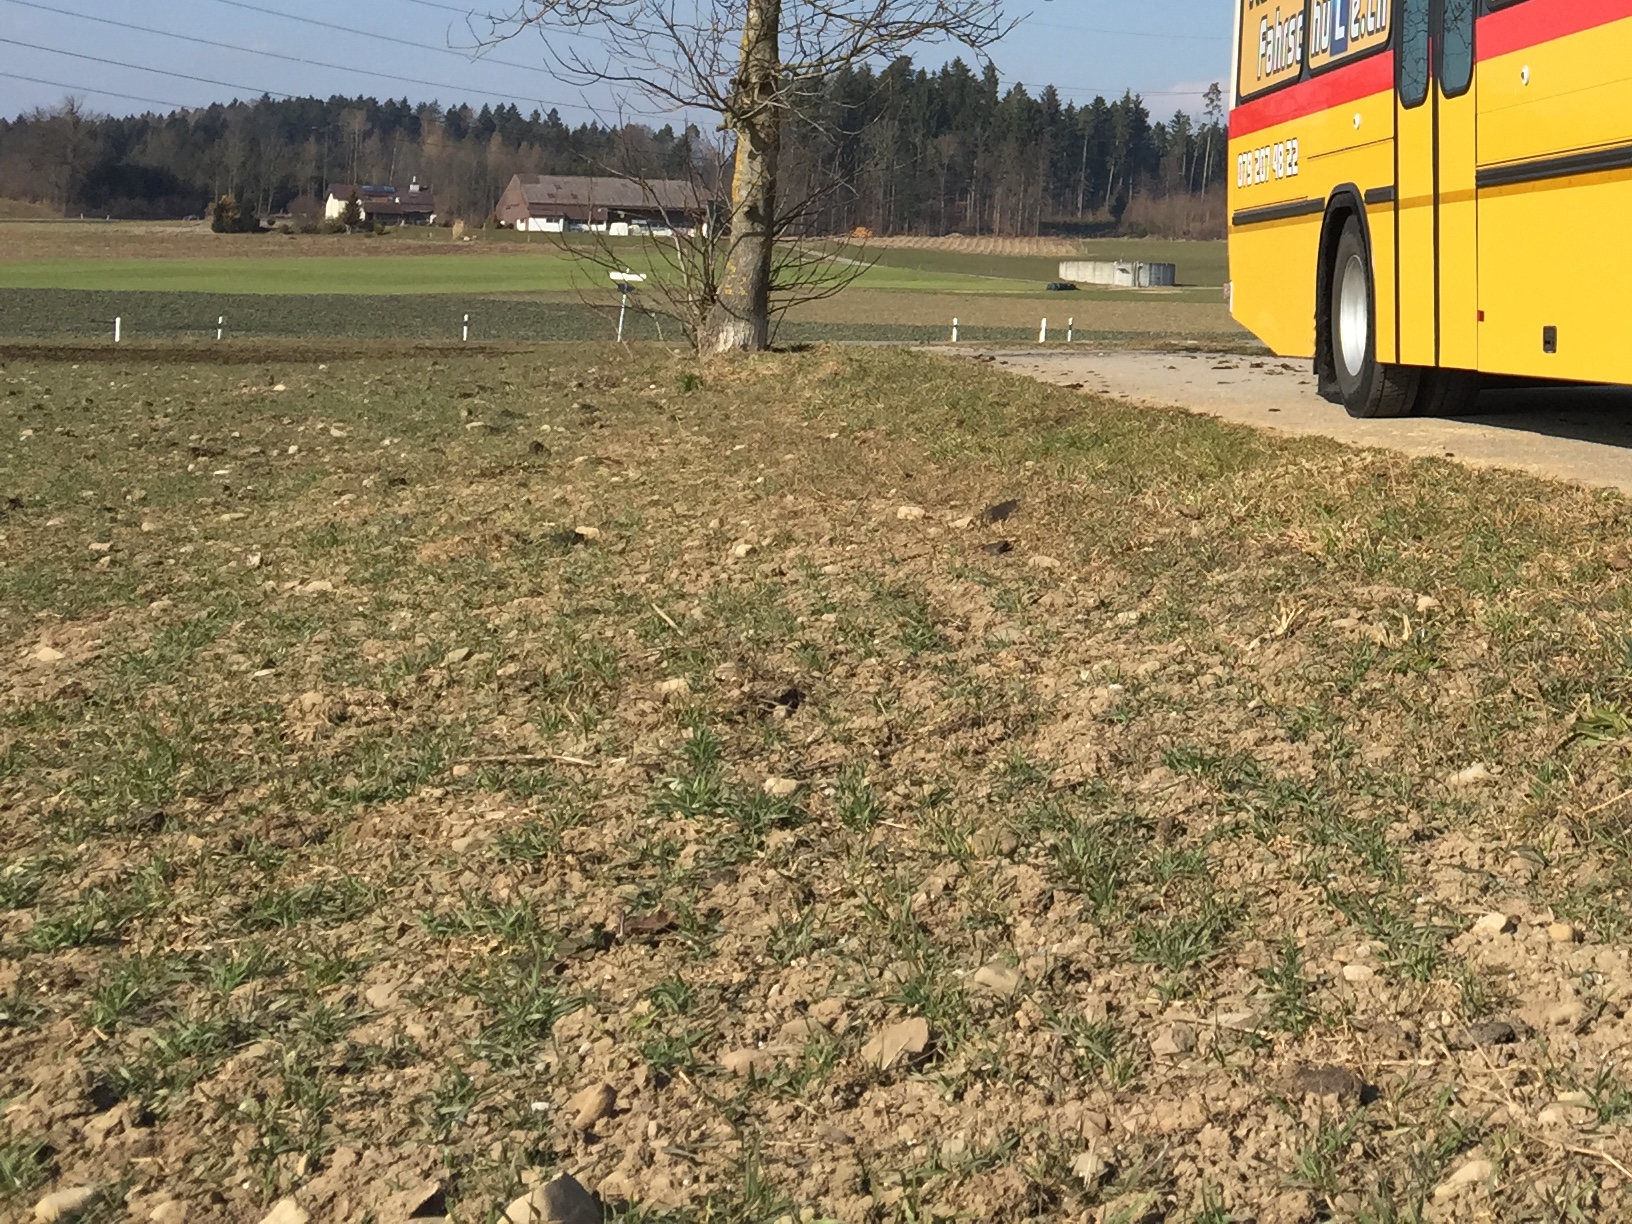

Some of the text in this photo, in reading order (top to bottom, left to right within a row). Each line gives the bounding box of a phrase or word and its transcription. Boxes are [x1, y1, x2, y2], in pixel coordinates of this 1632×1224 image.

[1237, 137, 1299, 189] 079 207 48 22
